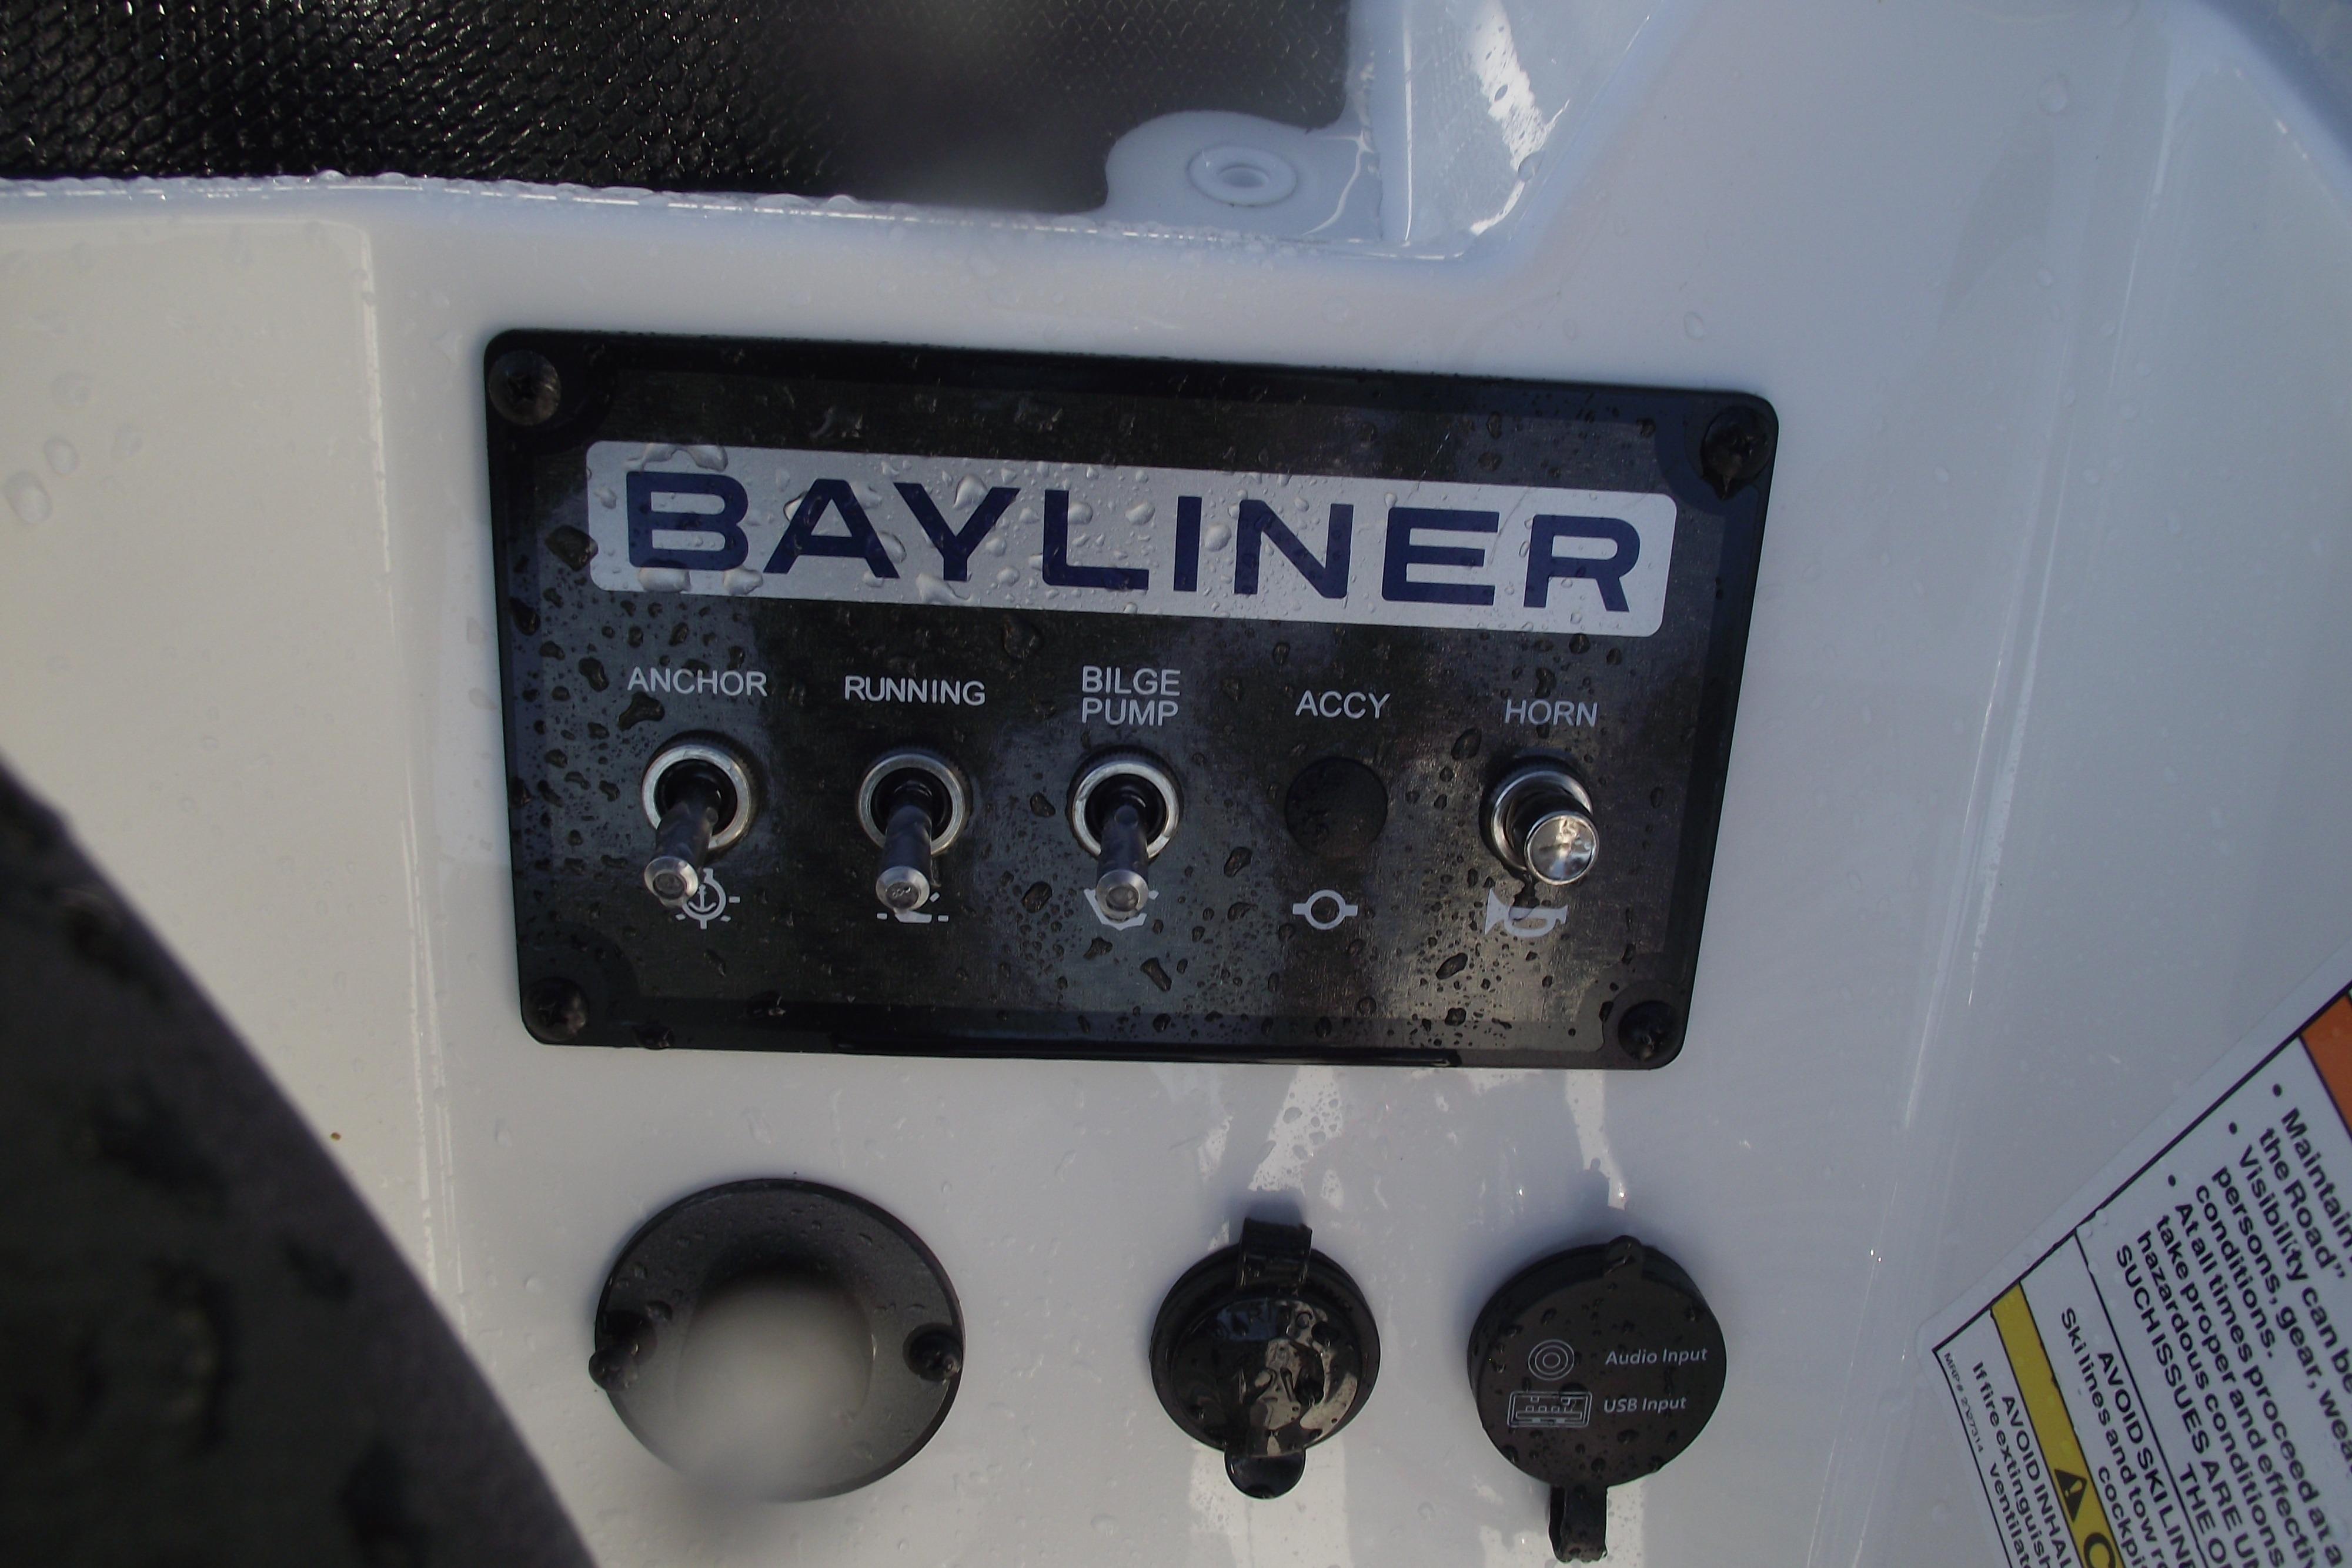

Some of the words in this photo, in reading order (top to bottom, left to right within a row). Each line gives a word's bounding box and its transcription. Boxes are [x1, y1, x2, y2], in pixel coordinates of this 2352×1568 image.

[627, 470, 1641, 612] BAYLINER
[627, 667, 768, 697] ANCHOR
[845, 675, 986, 706] RUNNING
[1081, 697, 1180, 727] PUMP
[1082, 665, 1181, 696] BILGE
[1295, 690, 1390, 720] ACCY
[1504, 699, 1598, 728] HORN
[2259, 1128, 2290, 1181] the
[2281, 1107, 2352, 1249] Maintain
[2196, 1185, 2275, 1358] conditions.
[2239, 1145, 2308, 1281] Visibility
[2302, 1287, 2337, 1348] can
[1605, 1350, 1658, 1365] Audio
[1662, 1348, 1708, 1365] Input
[2157, 1215, 2189, 1280] take
[2180, 1282, 2236, 1382] proper
[2229, 1389, 2267, 1450] and
[2211, 1166, 2280, 1305] persons,
[2276, 1306, 2322, 1389] gear,
[2319, 1388, 2352, 1474] wea
[1603, 1397, 1637, 1412] USB
[1642, 1396, 1687, 1412] Input
[1973, 1361, 1987, 1380] If
[1980, 1382, 1999, 1427] fire
[2061, 1308, 2086, 1354] Ski
[2079, 1353, 2110, 1426] lines
[2106, 1429, 2137, 1485] and
[2129, 1486, 2157, 1542] tow
[2117, 1245, 2160, 1333] SUCH
[2151, 1333, 2210, 1454] ISSUES
[2200, 1461, 2243, 1532] ARE
[2137, 1230, 2210, 1390] hazardous
[2204, 1393, 2284, 1568] conditions
[2175, 1204, 2199, 1237] At
[2191, 1238, 2217, 1274] all
[2209, 1274, 2253, 1363] times
[2243, 1365, 2320, 1503] proceed
[2308, 1507, 2330, 1542] at
[2002, 1397, 2040, 1480] AVOID
[2097, 1352, 2143, 1444] AVOID
[2137, 1446, 2167, 1503] SKI
[2098, 1466, 2146, 1568] cockpi
[2180, 1462, 2216, 1534] THE
[2208, 1537, 2232, 1568] O
